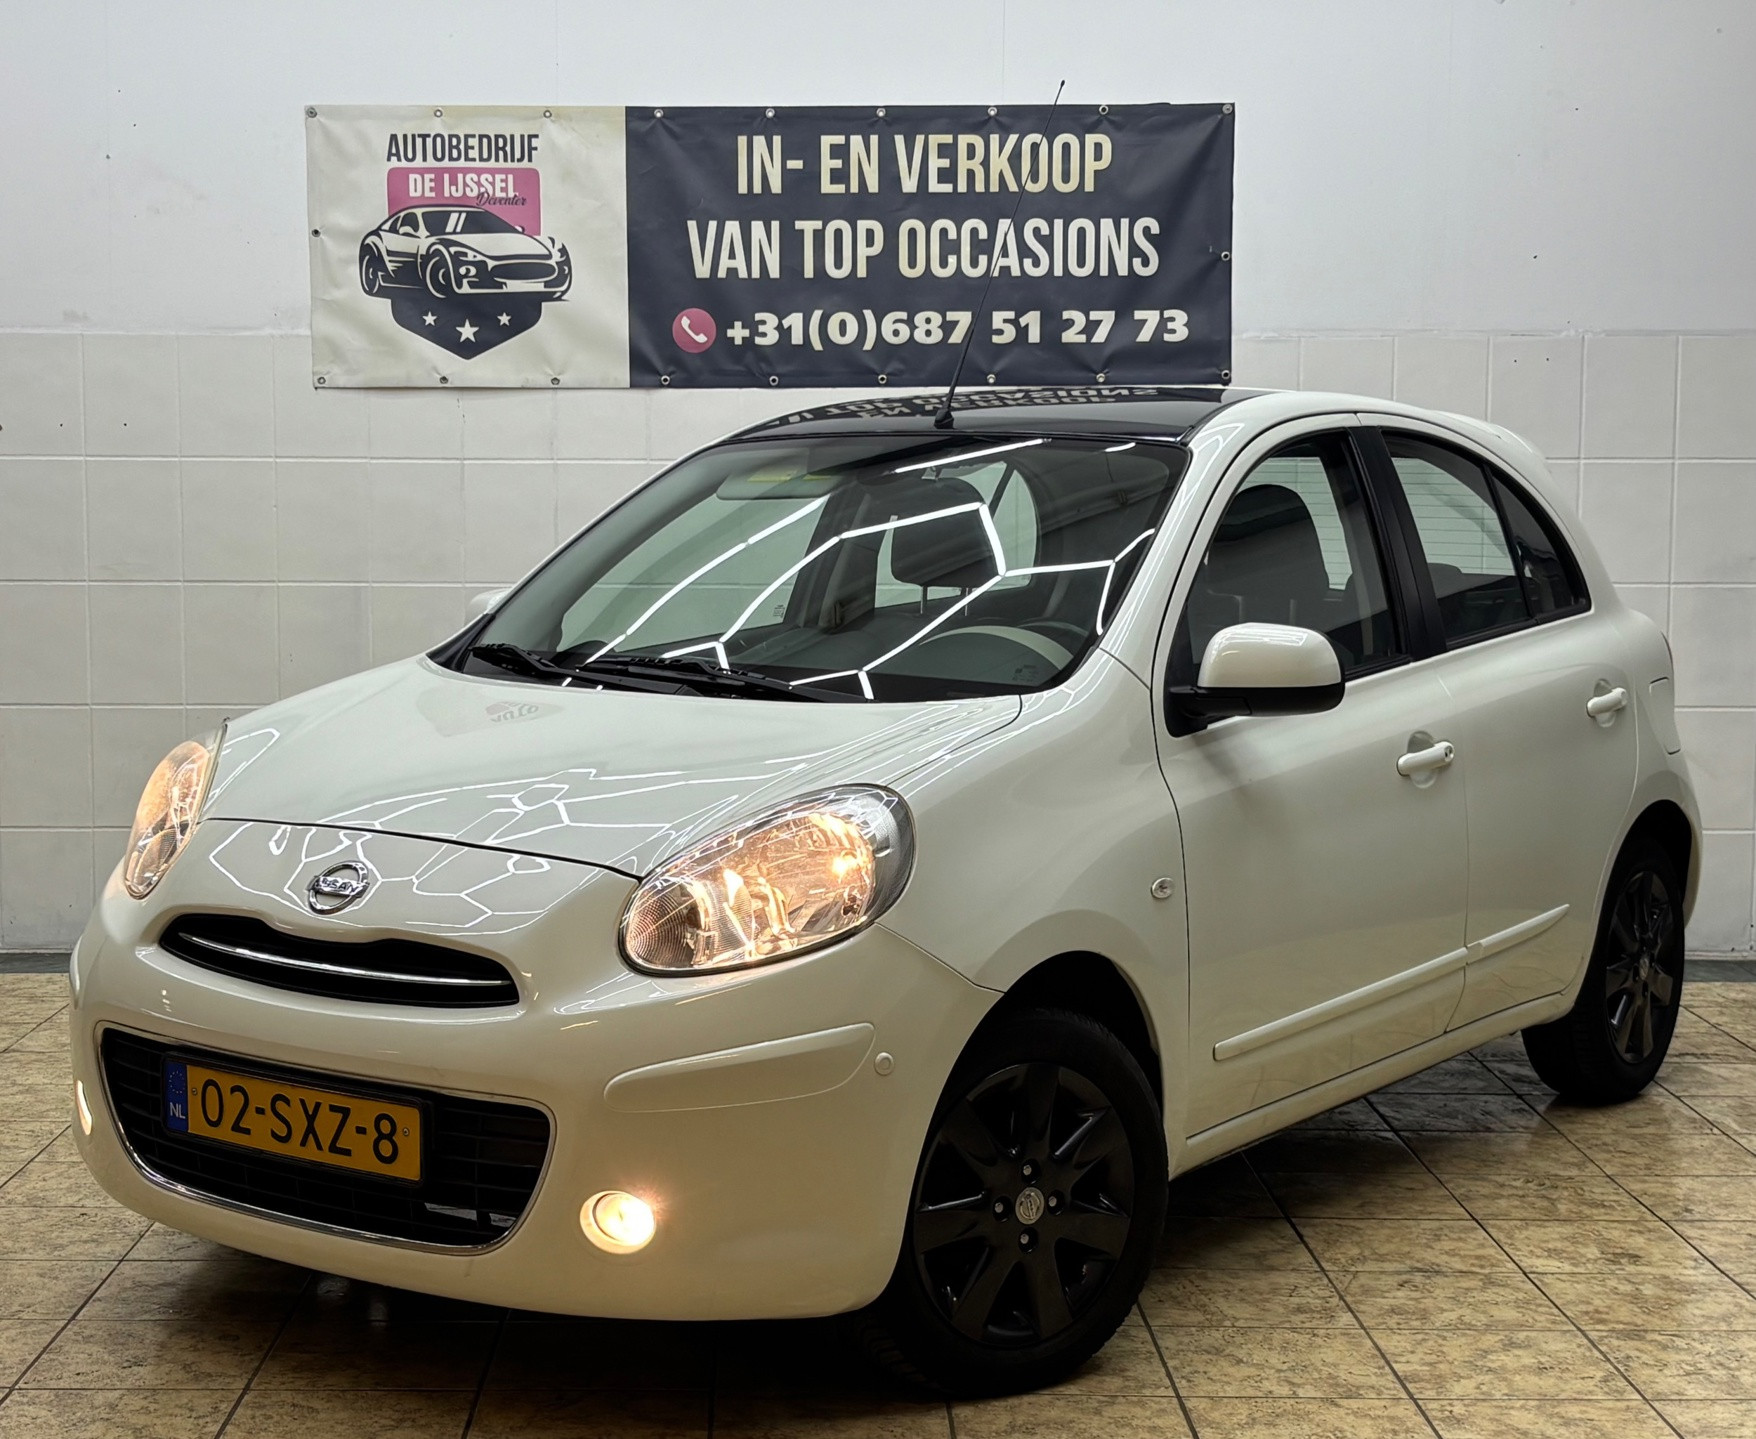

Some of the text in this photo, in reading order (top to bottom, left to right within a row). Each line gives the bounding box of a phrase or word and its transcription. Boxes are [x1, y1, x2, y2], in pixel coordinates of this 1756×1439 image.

[386, 132, 540, 163] AUTOBEDRIJF
[736, 132, 1113, 195] IN- EN VERKOOP
[408, 172, 519, 198] DE IJSSEL
[475, 190, 528, 207] Deventer
[686, 216, 1160, 279] VAN TOP OCCASIONS
[726, 308, 1190, 351] +31(0)687 51 27 73
[169, 1101, 186, 1120] NL
[200, 1078, 399, 1165] 02-SXZ-8
